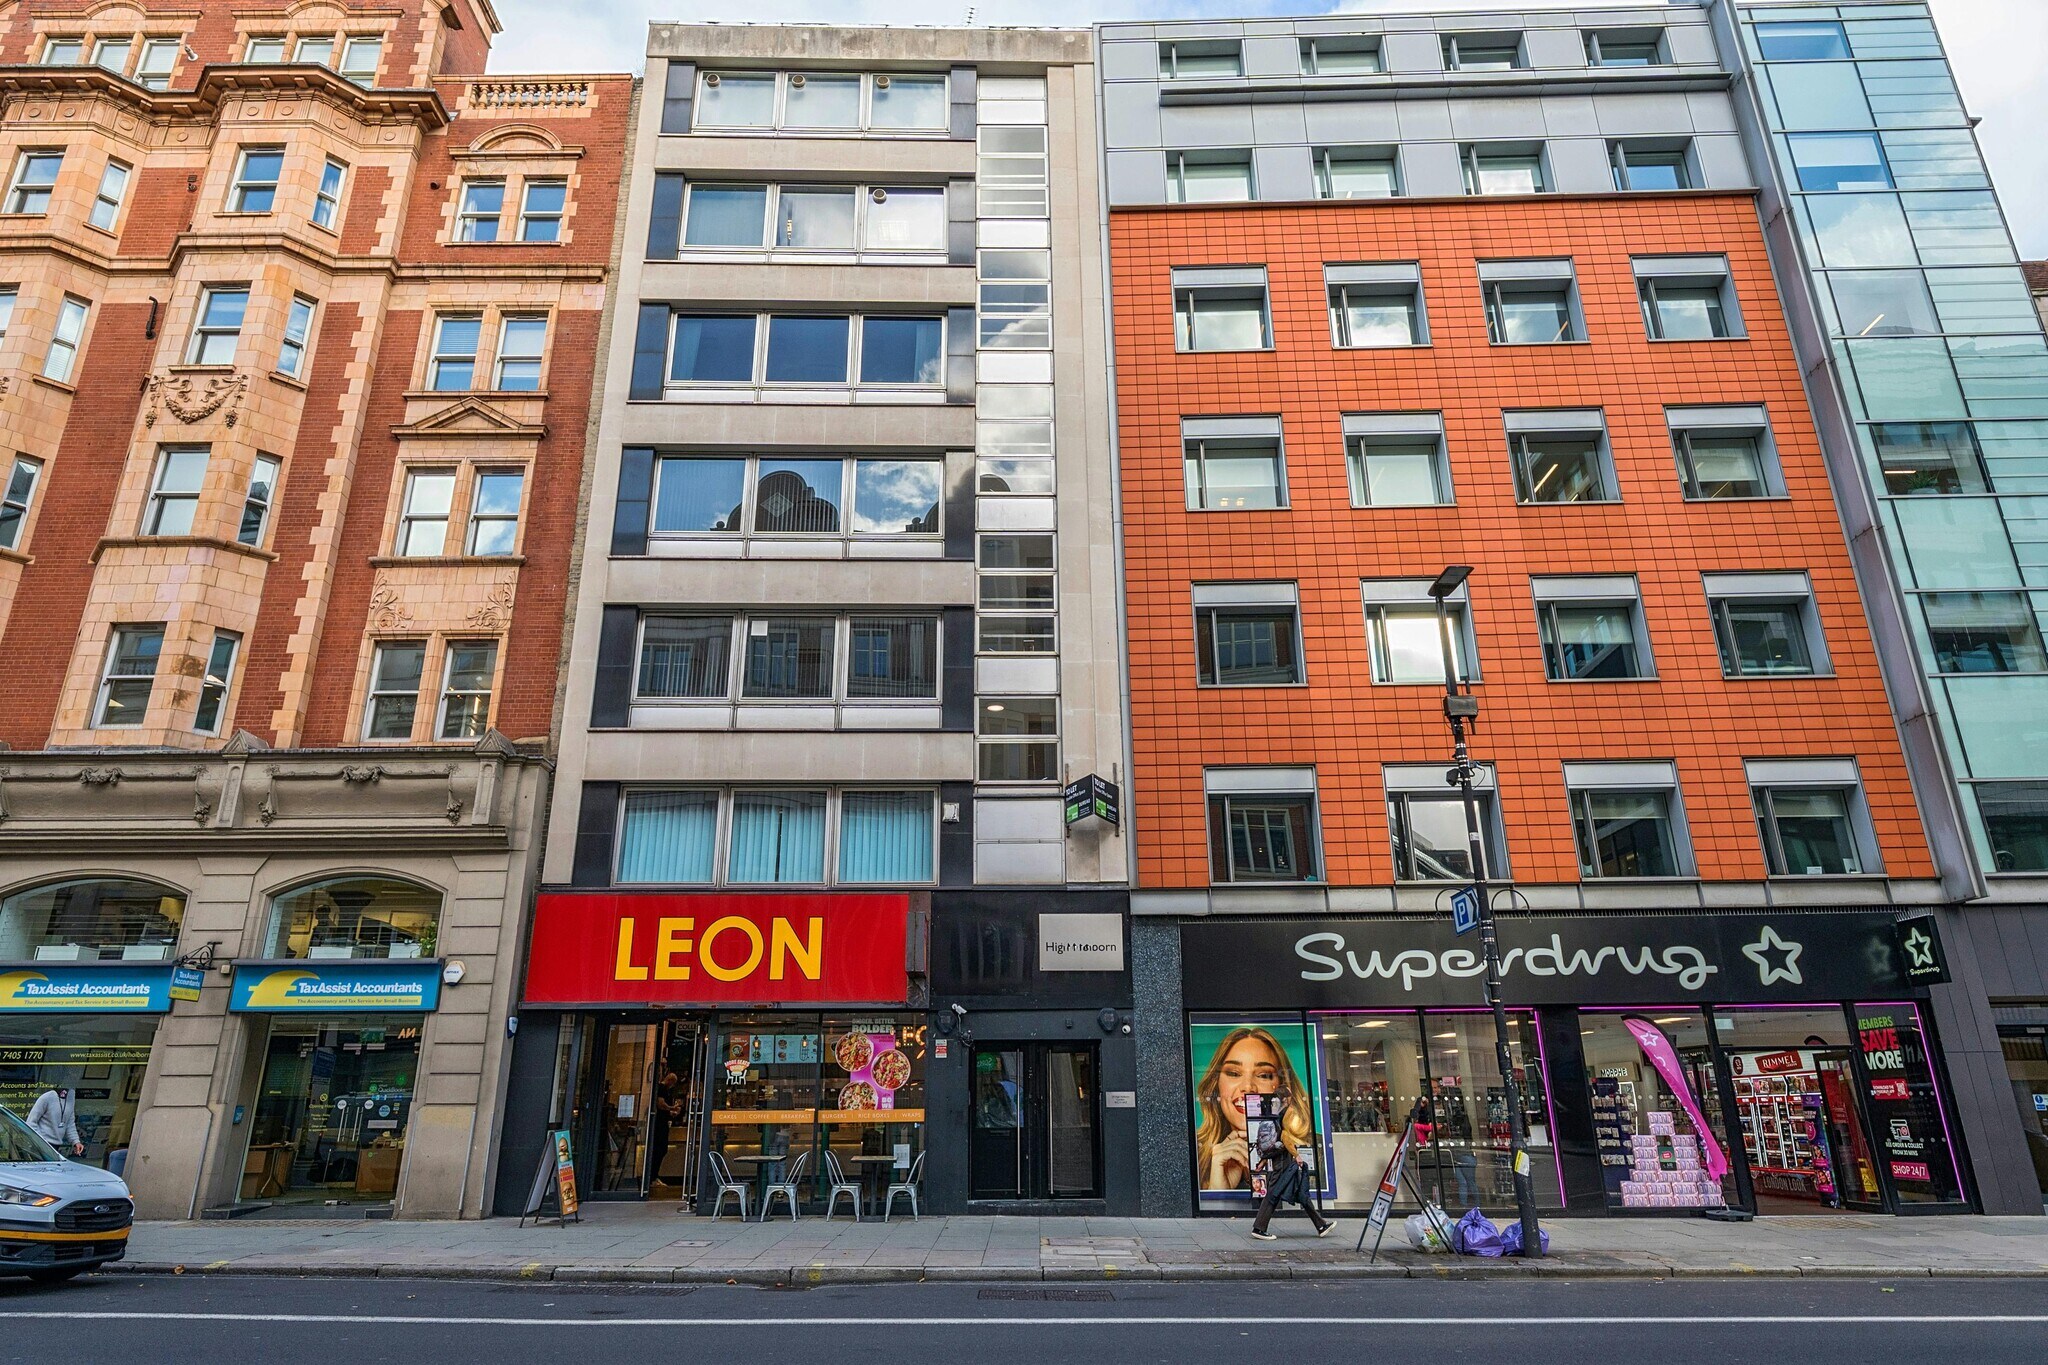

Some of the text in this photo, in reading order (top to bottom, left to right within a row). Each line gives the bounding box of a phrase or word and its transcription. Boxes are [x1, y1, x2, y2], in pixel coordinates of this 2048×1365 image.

[1458, 902, 1466, 924] P
[614, 915, 824, 982] LEON
[1295, 932, 1718, 991] Superdrug
[179, 971, 200, 980] TaxAssist
[1909, 966, 1940, 976] Superdrug
[27, 983, 150, 995] TaxAssist Accountants
[174, 978, 201, 988] Accountants
[299, 982, 423, 994] TaxAssist Accountants
[1860, 1028, 1900, 1052] SAVE
[2, 1051, 44, 1060] 7405 1770
[1762, 1055, 1797, 1069] RIMMEL
[1893, 1165, 1926, 1177] SHOP 24/7
